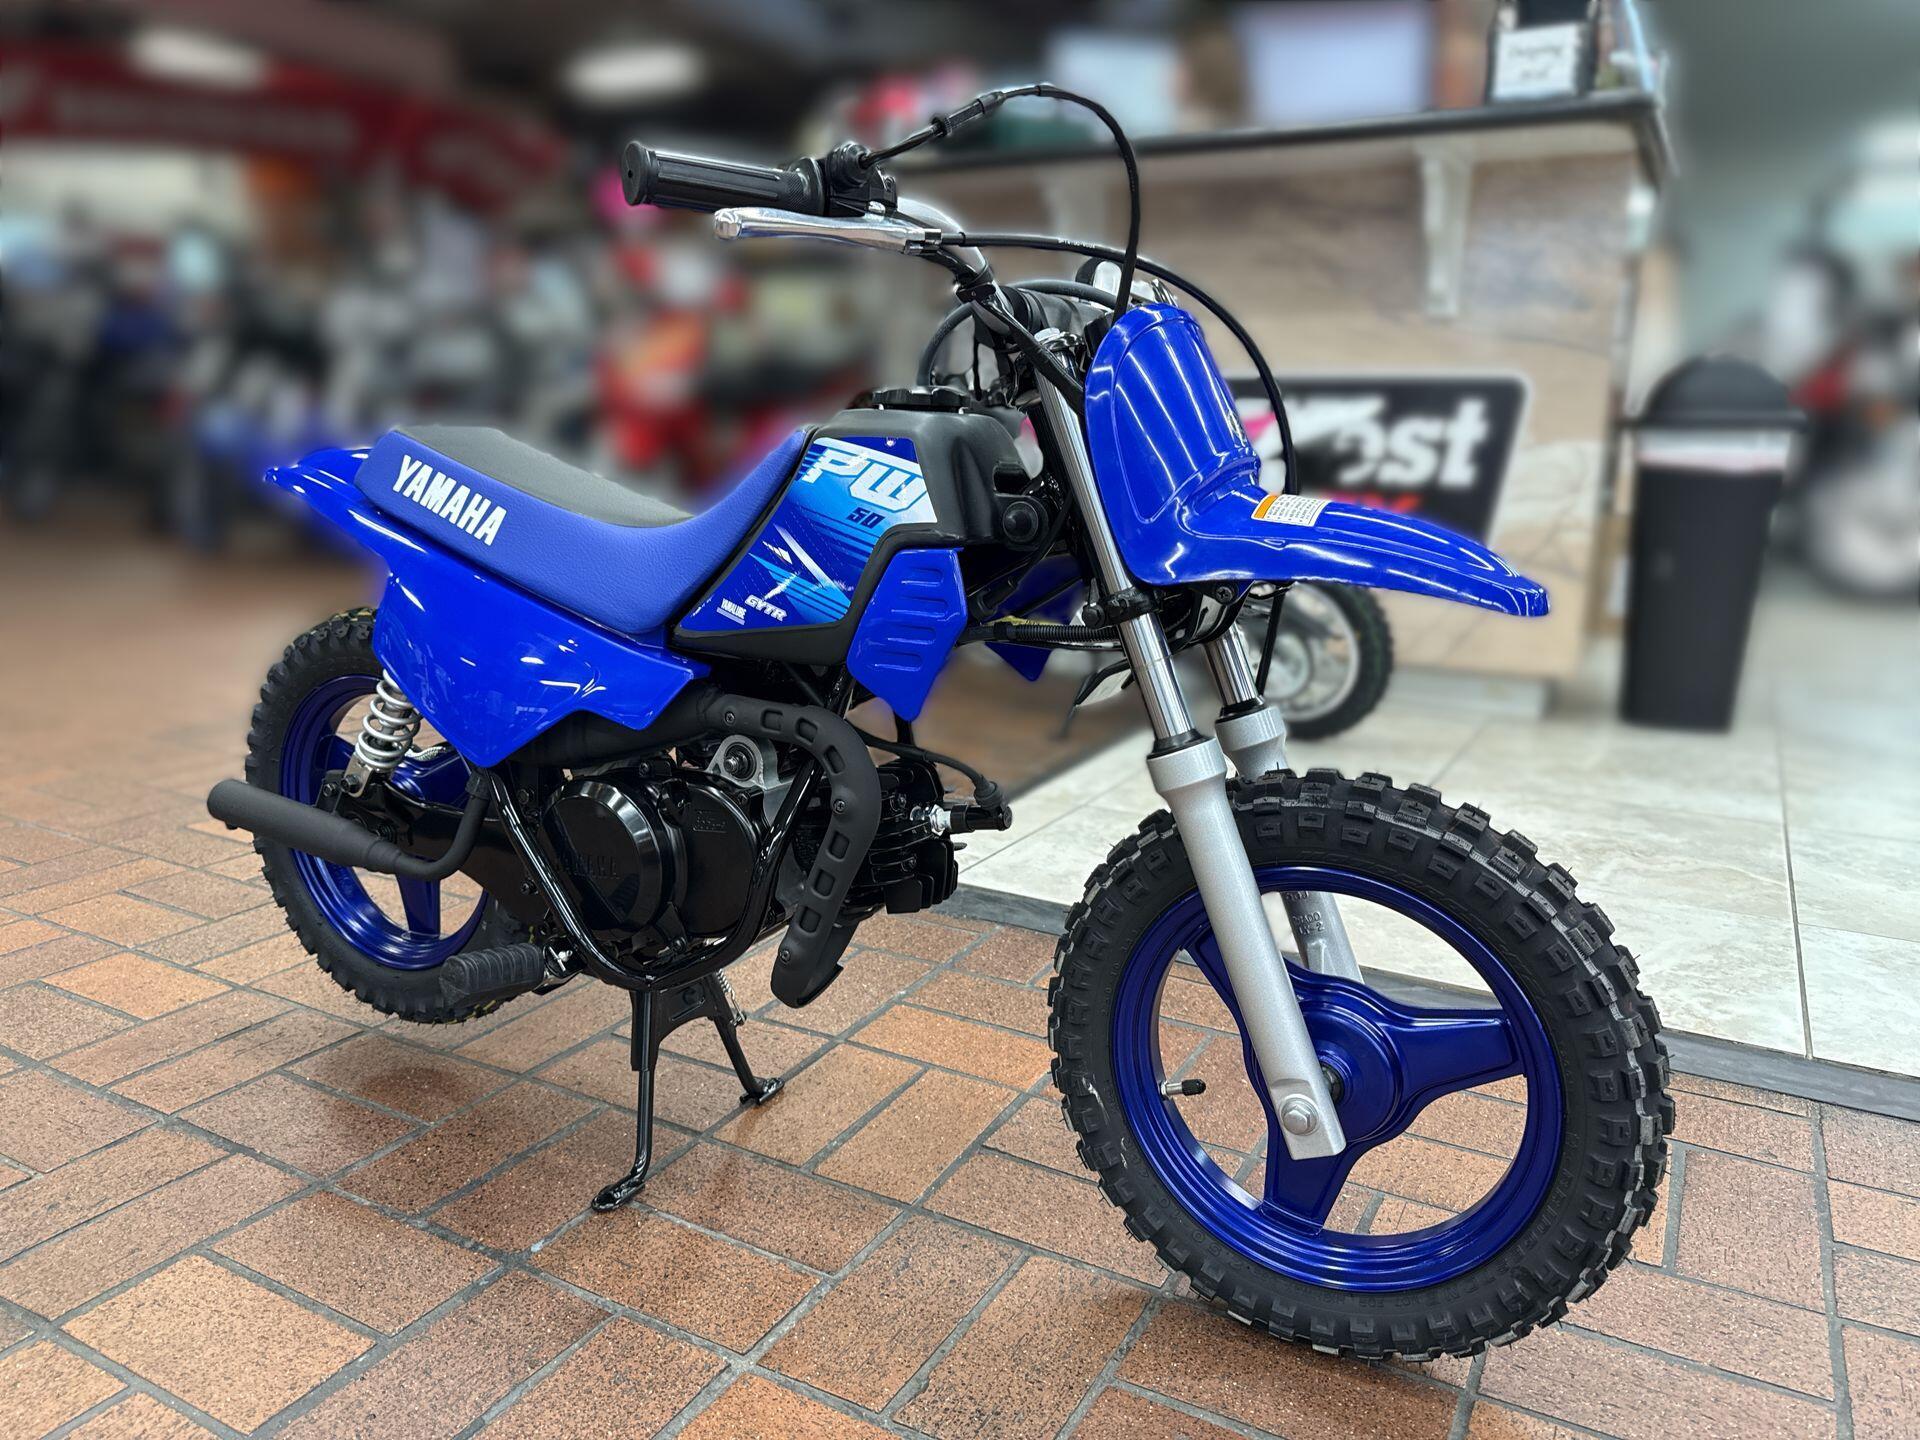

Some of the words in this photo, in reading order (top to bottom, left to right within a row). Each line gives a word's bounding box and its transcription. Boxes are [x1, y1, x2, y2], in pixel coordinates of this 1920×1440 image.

[392, 454, 507, 546] YAMAHA
[801, 447, 928, 513] PW
[847, 507, 886, 529] 50
[744, 594, 788, 622] GYTR
